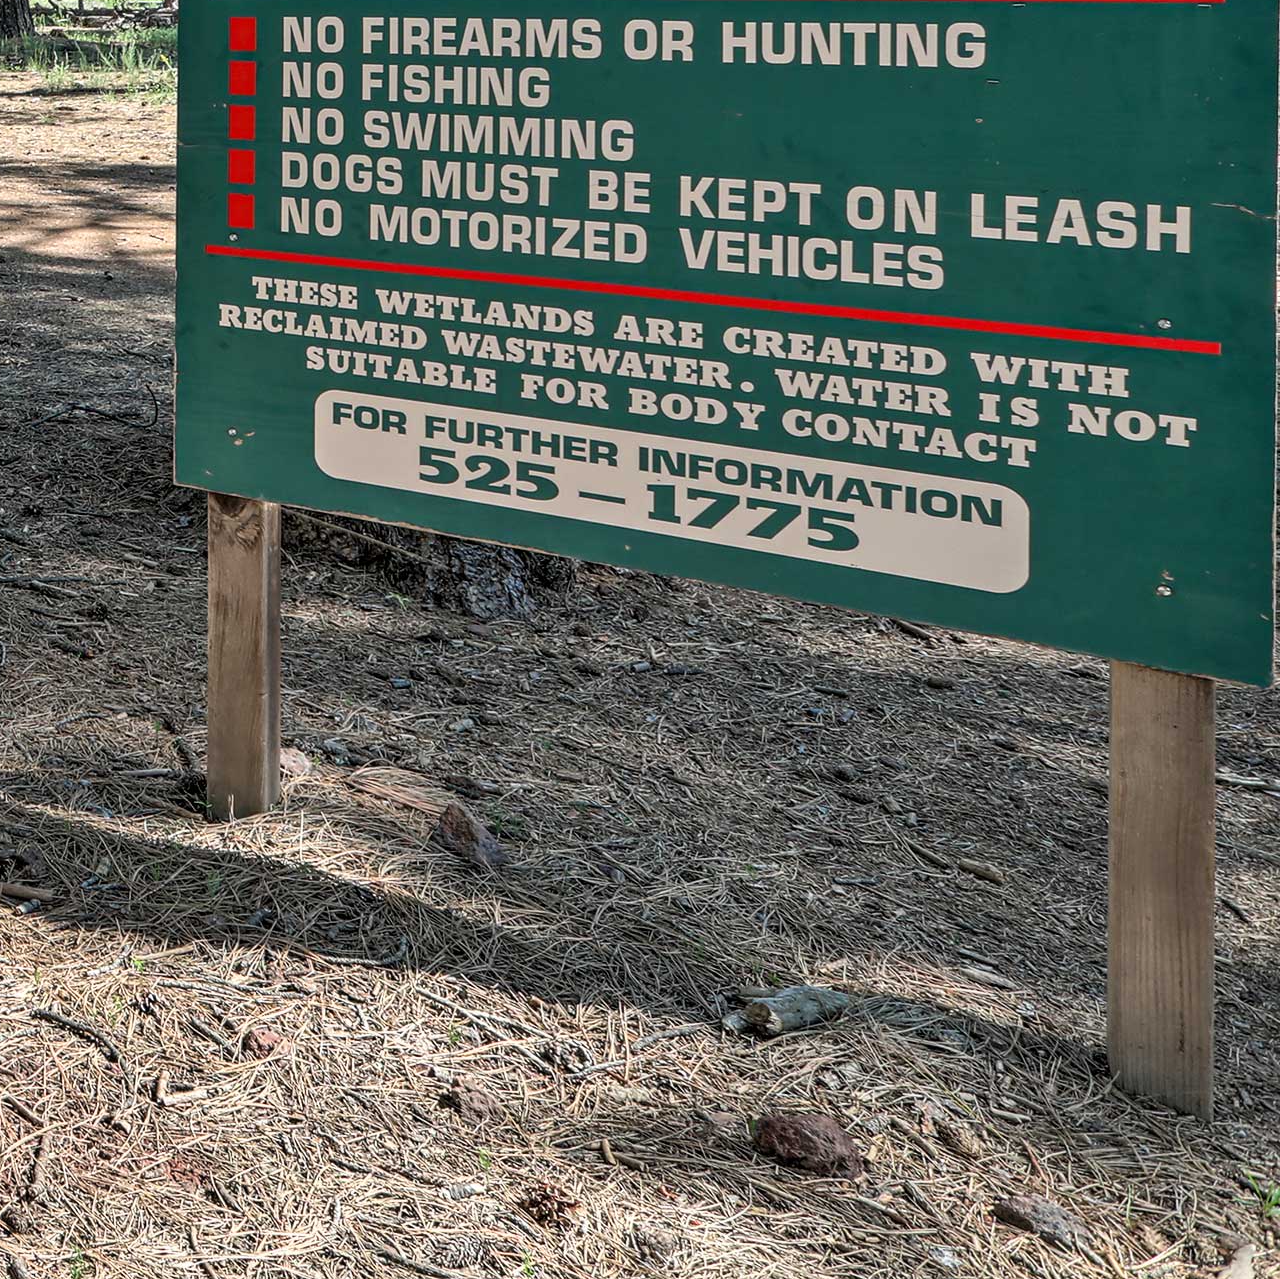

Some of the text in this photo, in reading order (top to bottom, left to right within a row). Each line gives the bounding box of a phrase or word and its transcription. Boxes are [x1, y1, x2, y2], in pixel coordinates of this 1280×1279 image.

[282, 16, 986, 69] NO FIREARMS OR HUNTING
[282, 61, 550, 108] NO FISHING
[281, 106, 634, 162] NO SWIMMING
[280, 196, 944, 290] NO MOTORIZED VEHICLES
[281, 151, 1191, 254] DOGS MUST BE KEPT ON LEASH
[218, 303, 428, 350] RECLAIMED
[774, 368, 952, 417] WATER
[978, 392, 1040, 428] IS
[1067, 402, 1197, 448] NOT
[251, 275, 1130, 398] THESE WETLANDS ARE CREATED WITH
[305, 345, 1037, 468] SUITABLE FOR BODY CONTACT
[332, 401, 1003, 528] FOR FURTHER INFORMATION
[419, 445, 560, 501] 525
[646, 484, 860, 552] 1775
